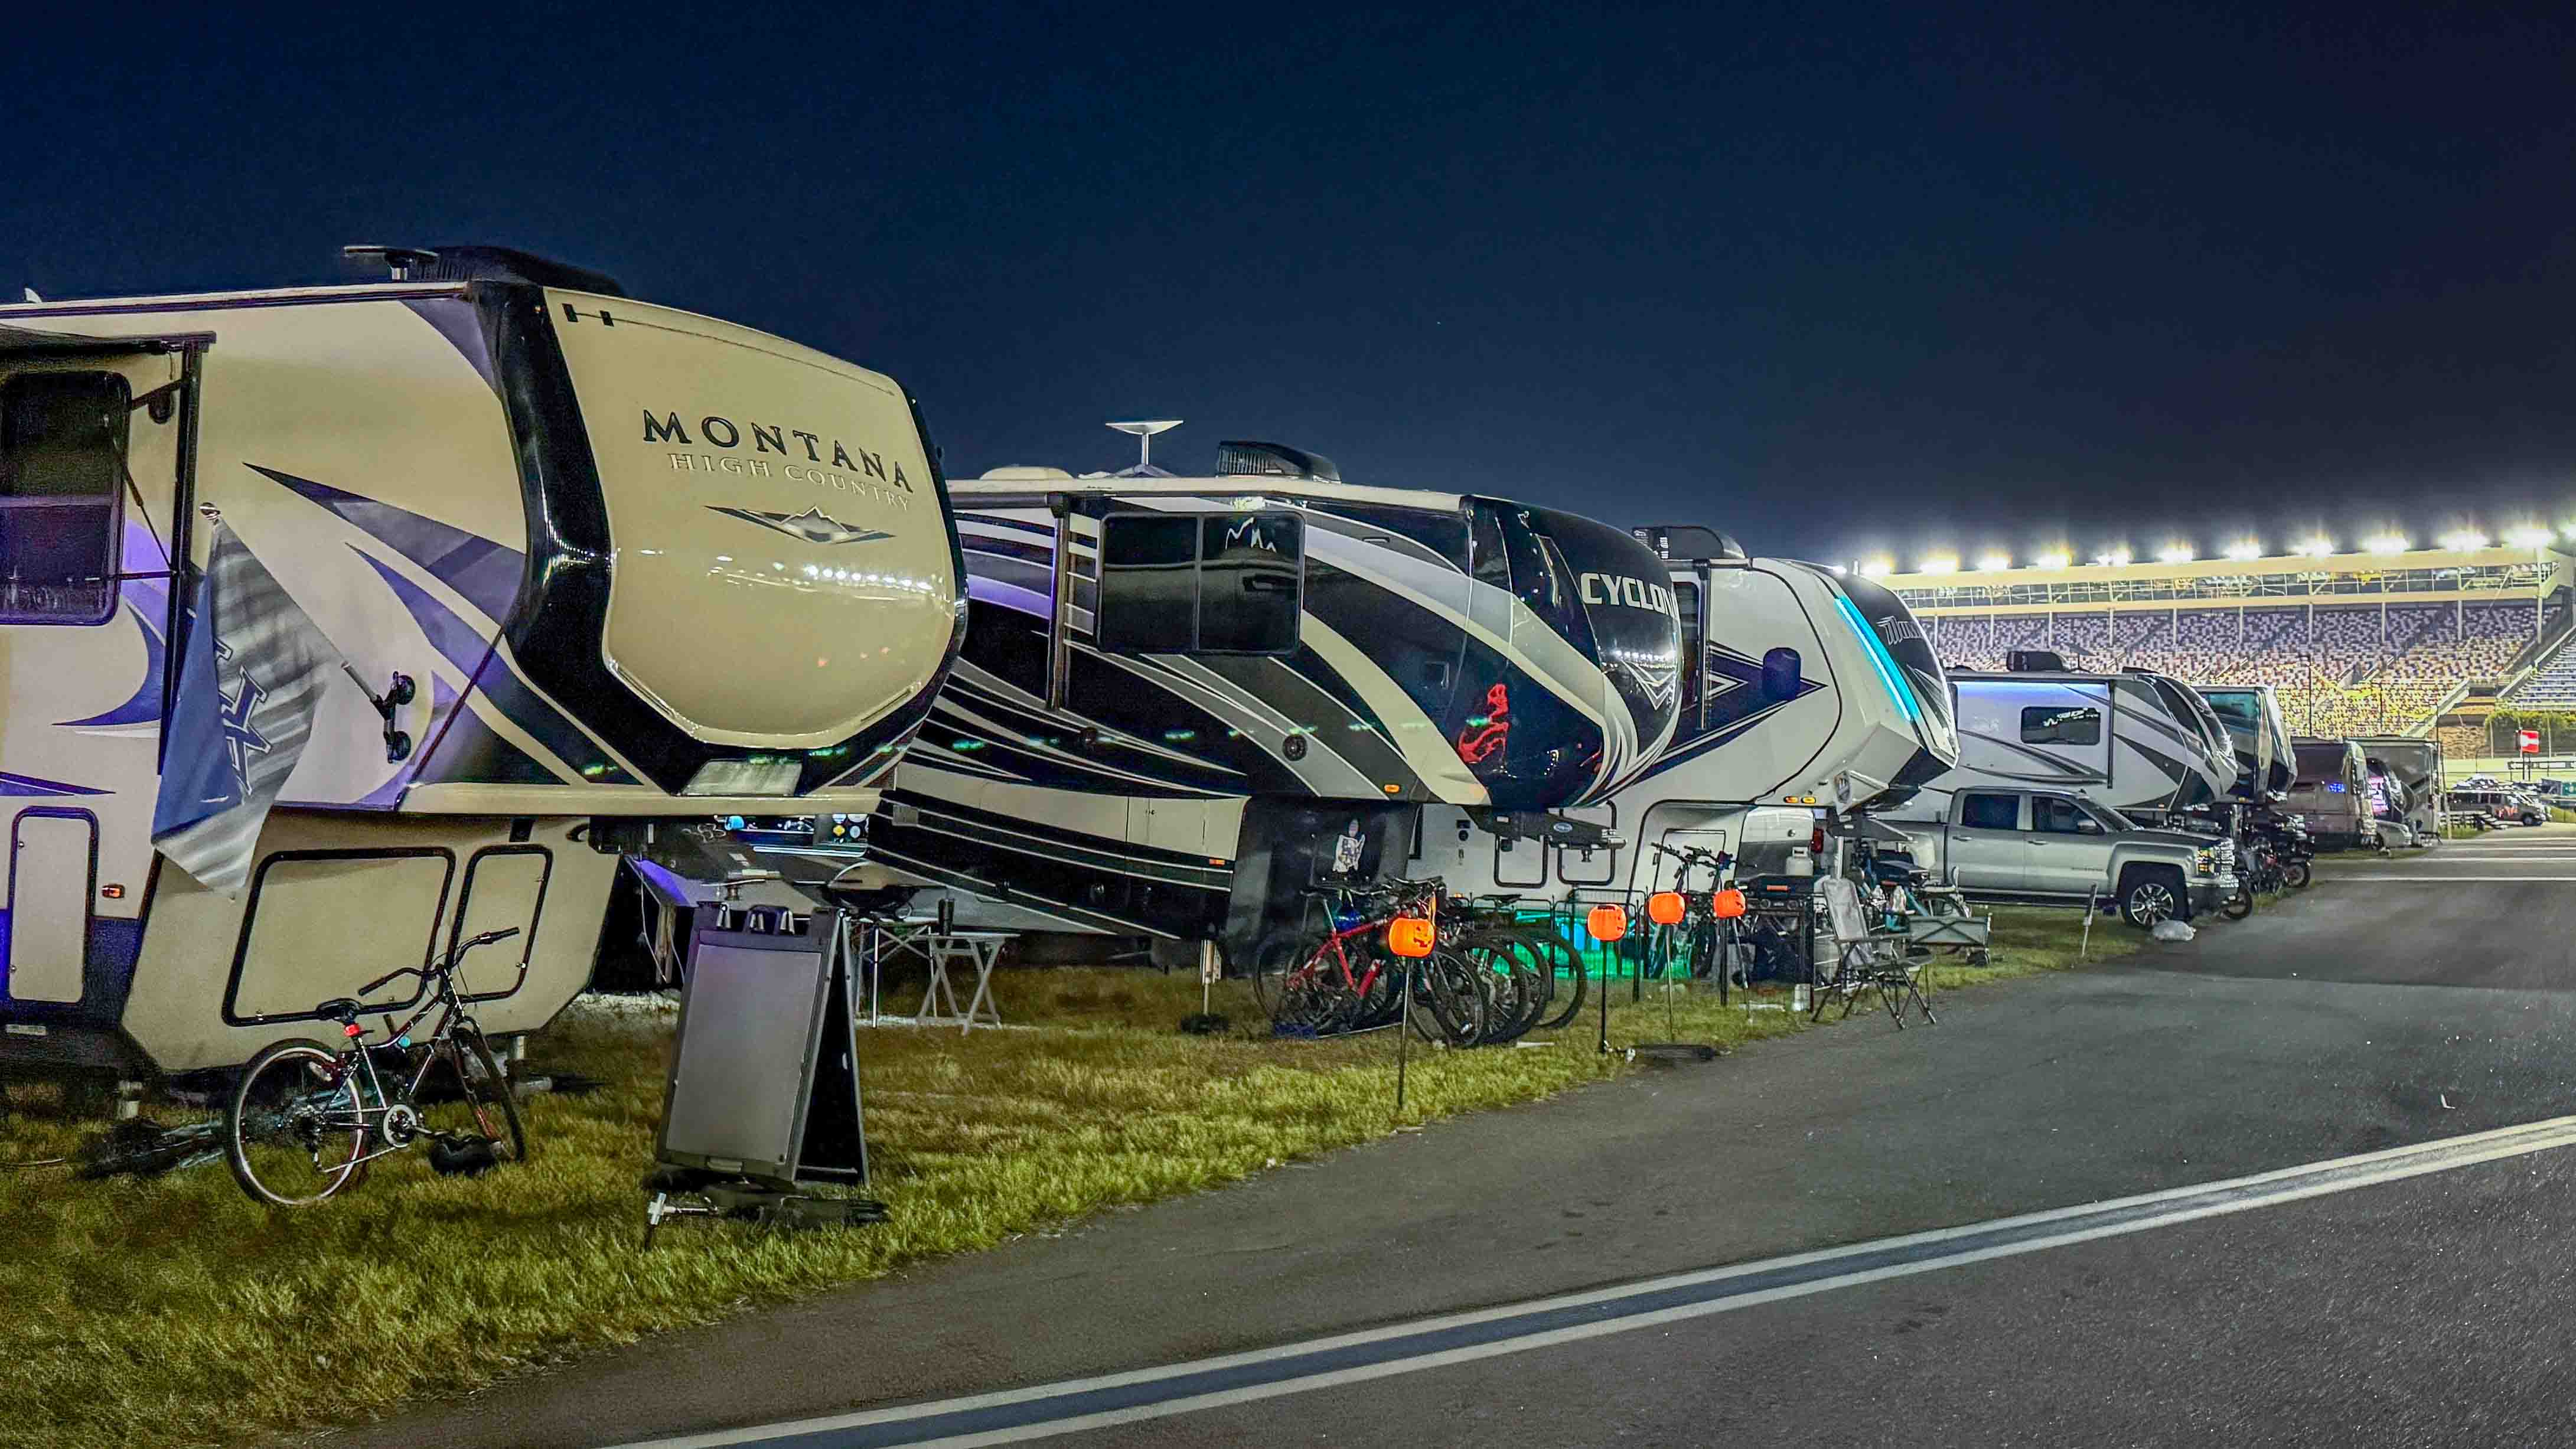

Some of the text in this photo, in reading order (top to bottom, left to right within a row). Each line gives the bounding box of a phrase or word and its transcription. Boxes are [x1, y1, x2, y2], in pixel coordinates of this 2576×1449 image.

[643, 409, 914, 494] MONTANA
[670, 452, 911, 511] HIGH COUNTRY
[1580, 572, 1680, 619] CYCLON
